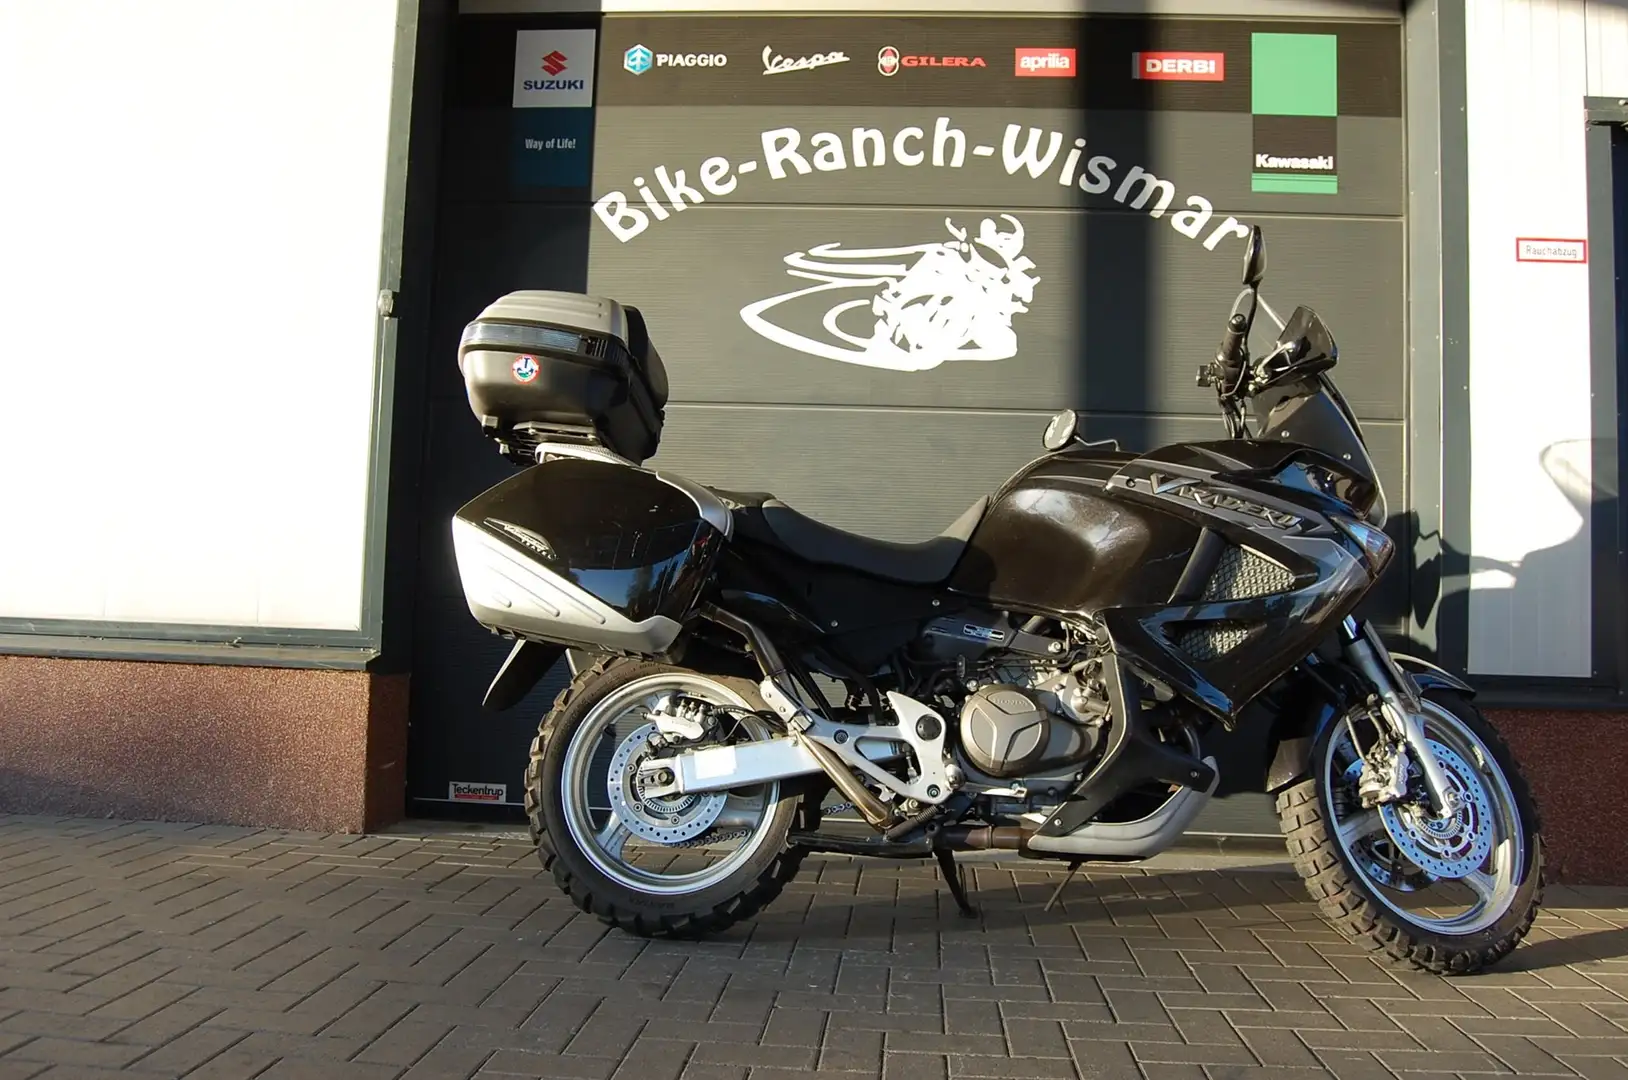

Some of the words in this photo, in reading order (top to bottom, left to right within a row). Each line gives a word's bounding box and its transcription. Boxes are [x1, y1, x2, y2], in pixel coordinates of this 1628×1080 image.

[656, 53, 728, 68] PIAGGIO
[762, 45, 851, 75] Vespa
[901, 55, 987, 68] GILERA
[1020, 52, 1070, 72] aprilia
[1146, 59, 1216, 74] DERBI
[523, 80, 584, 91] SUZUKI
[525, 138, 544, 151] Way
[545, 138, 556, 149] of
[557, 138, 577, 149] Life!
[1255, 153, 1334, 170] Kawasaki
[593, 116, 1249, 251] Bike-Ranch-Wismar
[452, 784, 504, 800] Teckentrup
